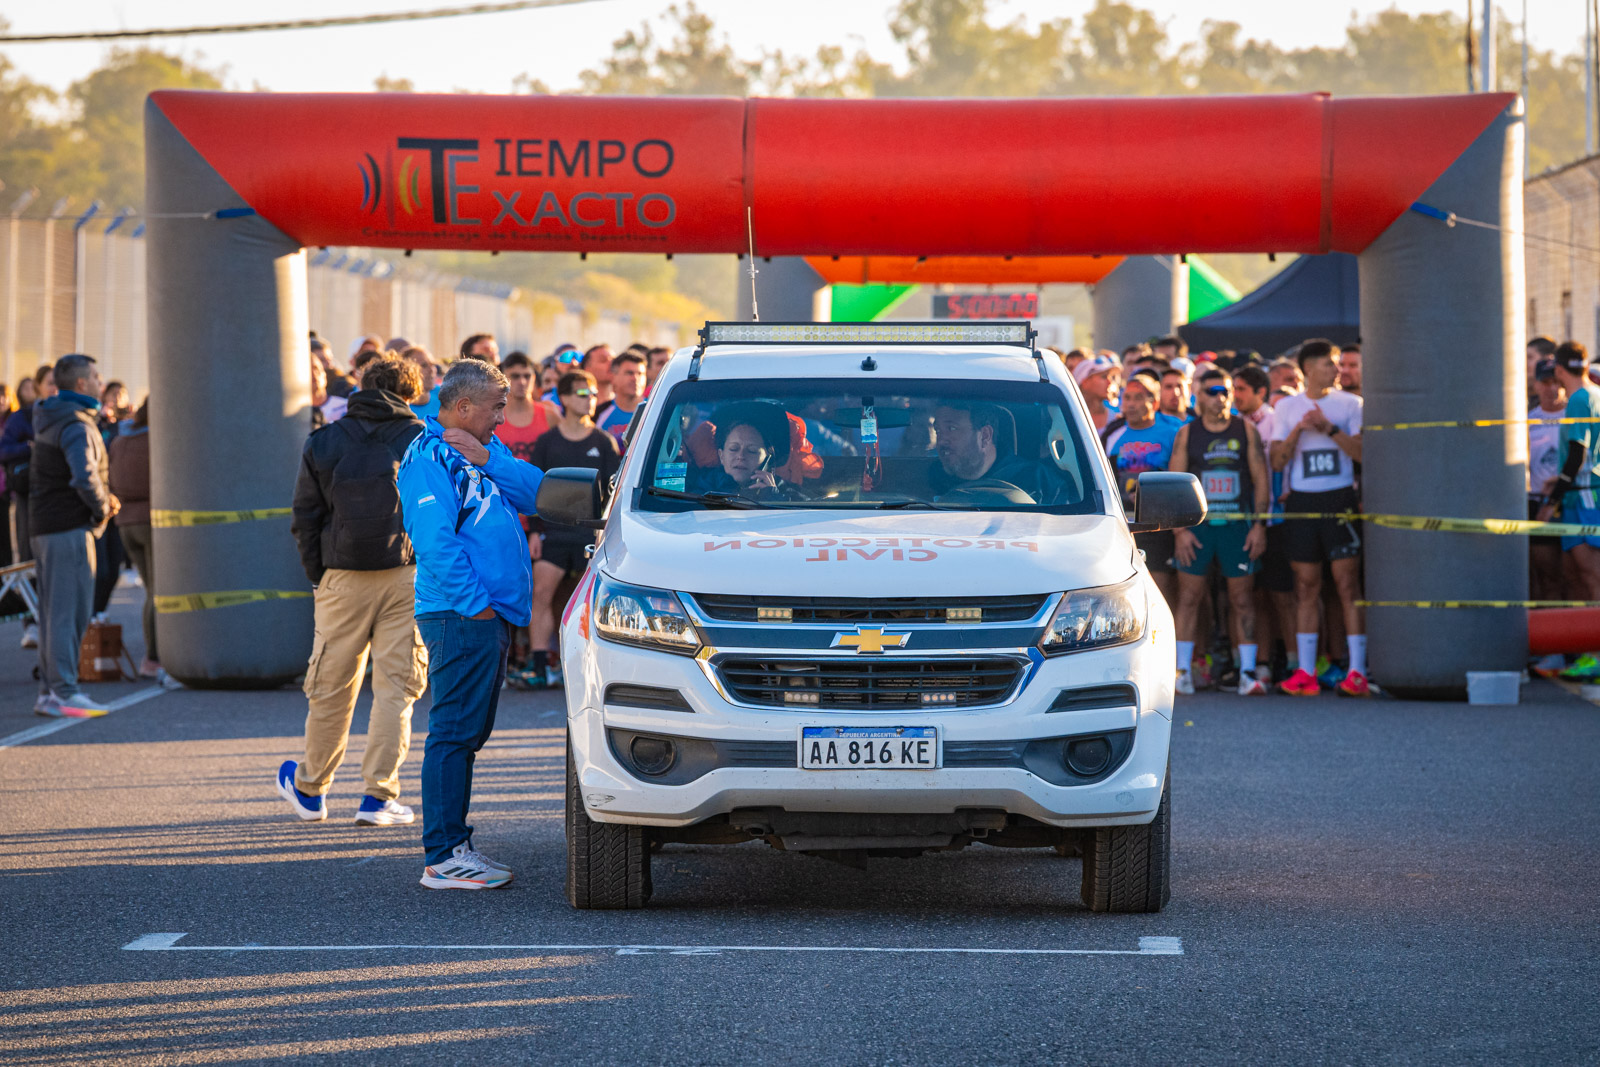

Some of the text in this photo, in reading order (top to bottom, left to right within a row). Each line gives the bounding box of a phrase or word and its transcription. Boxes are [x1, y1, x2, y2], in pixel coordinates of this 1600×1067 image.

[1309, 453, 1335, 473] 106
[1207, 477, 1233, 493] 317
[810, 741, 930, 764] AA 816 KE
